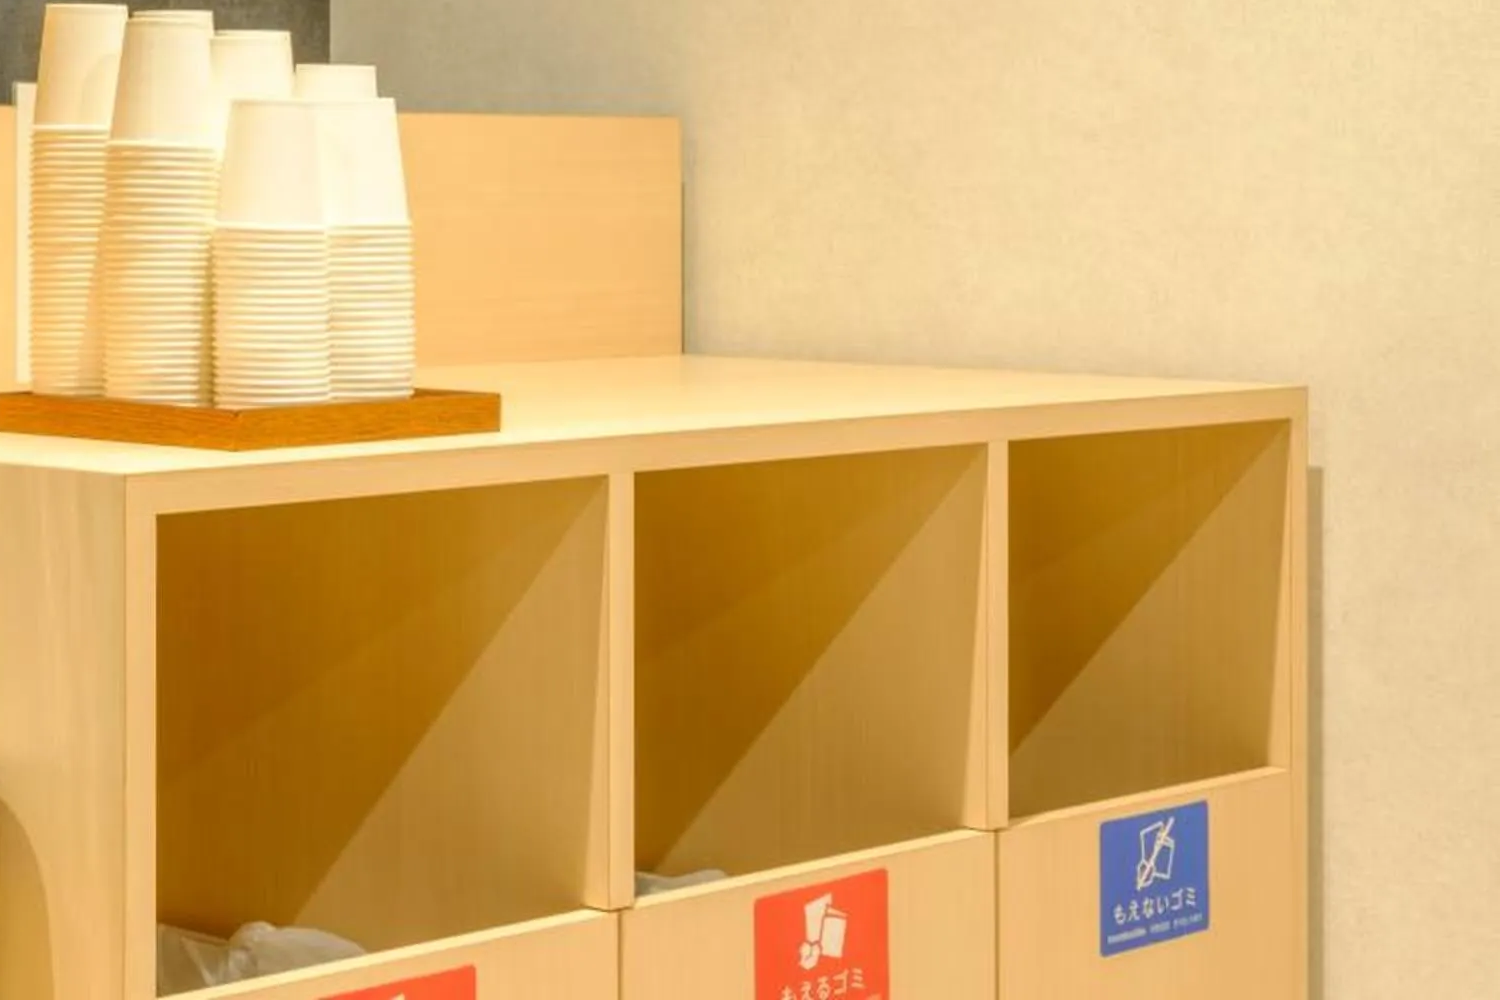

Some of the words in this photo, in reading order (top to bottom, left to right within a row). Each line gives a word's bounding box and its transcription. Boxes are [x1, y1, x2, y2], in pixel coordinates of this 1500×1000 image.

[1112, 886, 1197, 926] もえないゴミ
